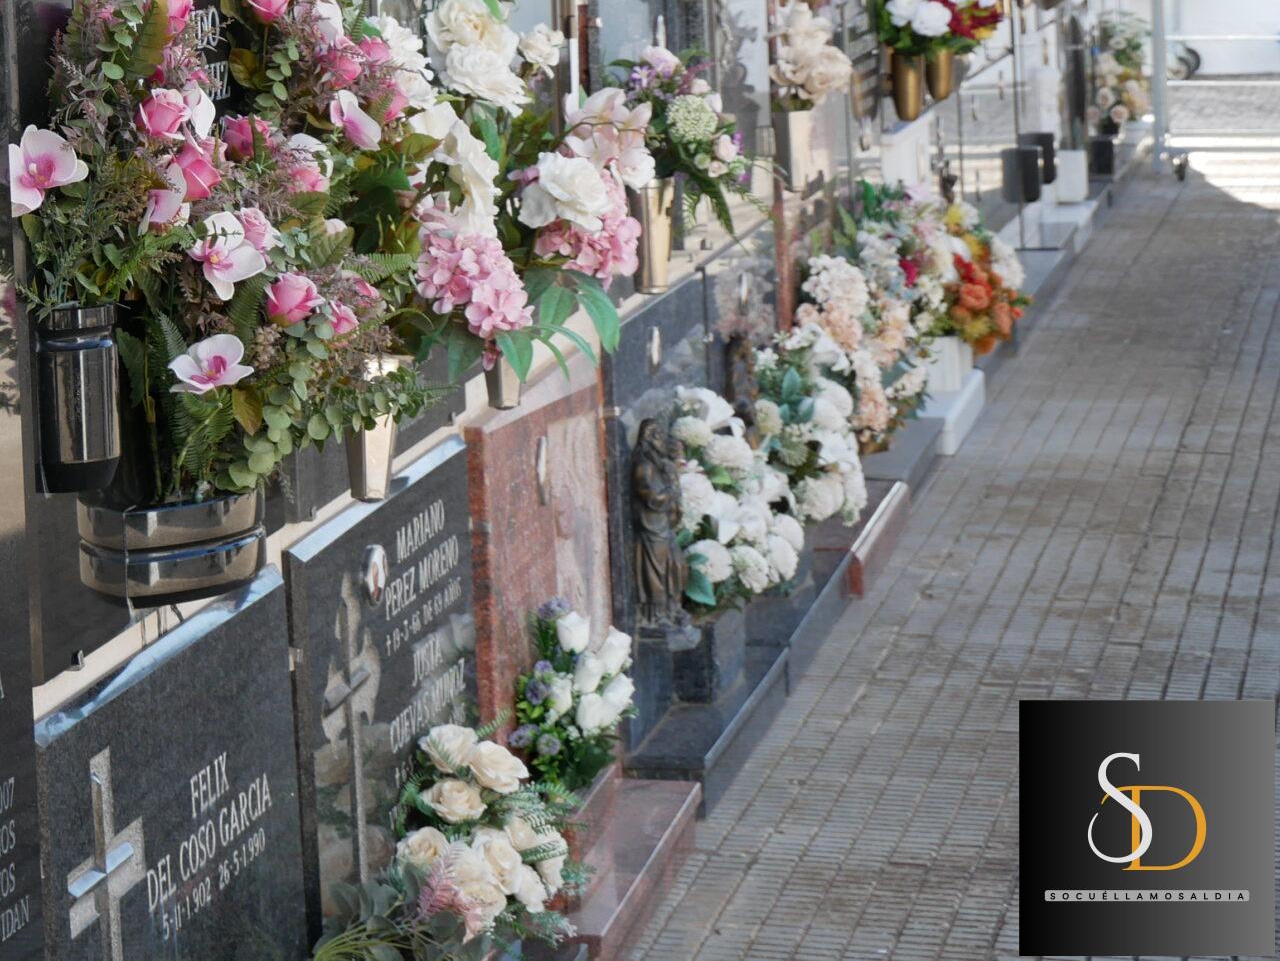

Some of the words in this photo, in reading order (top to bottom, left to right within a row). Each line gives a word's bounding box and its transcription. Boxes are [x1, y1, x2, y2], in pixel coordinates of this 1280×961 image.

[396, 498, 446, 564] MARIANO
[384, 566, 417, 621] PEREZ
[418, 535, 460, 594] MORENO
[189, 751, 231, 819] FELIX
[146, 853, 178, 914] DEL
[179, 819, 217, 882] COSO
[219, 772, 273, 848] GARCIA
